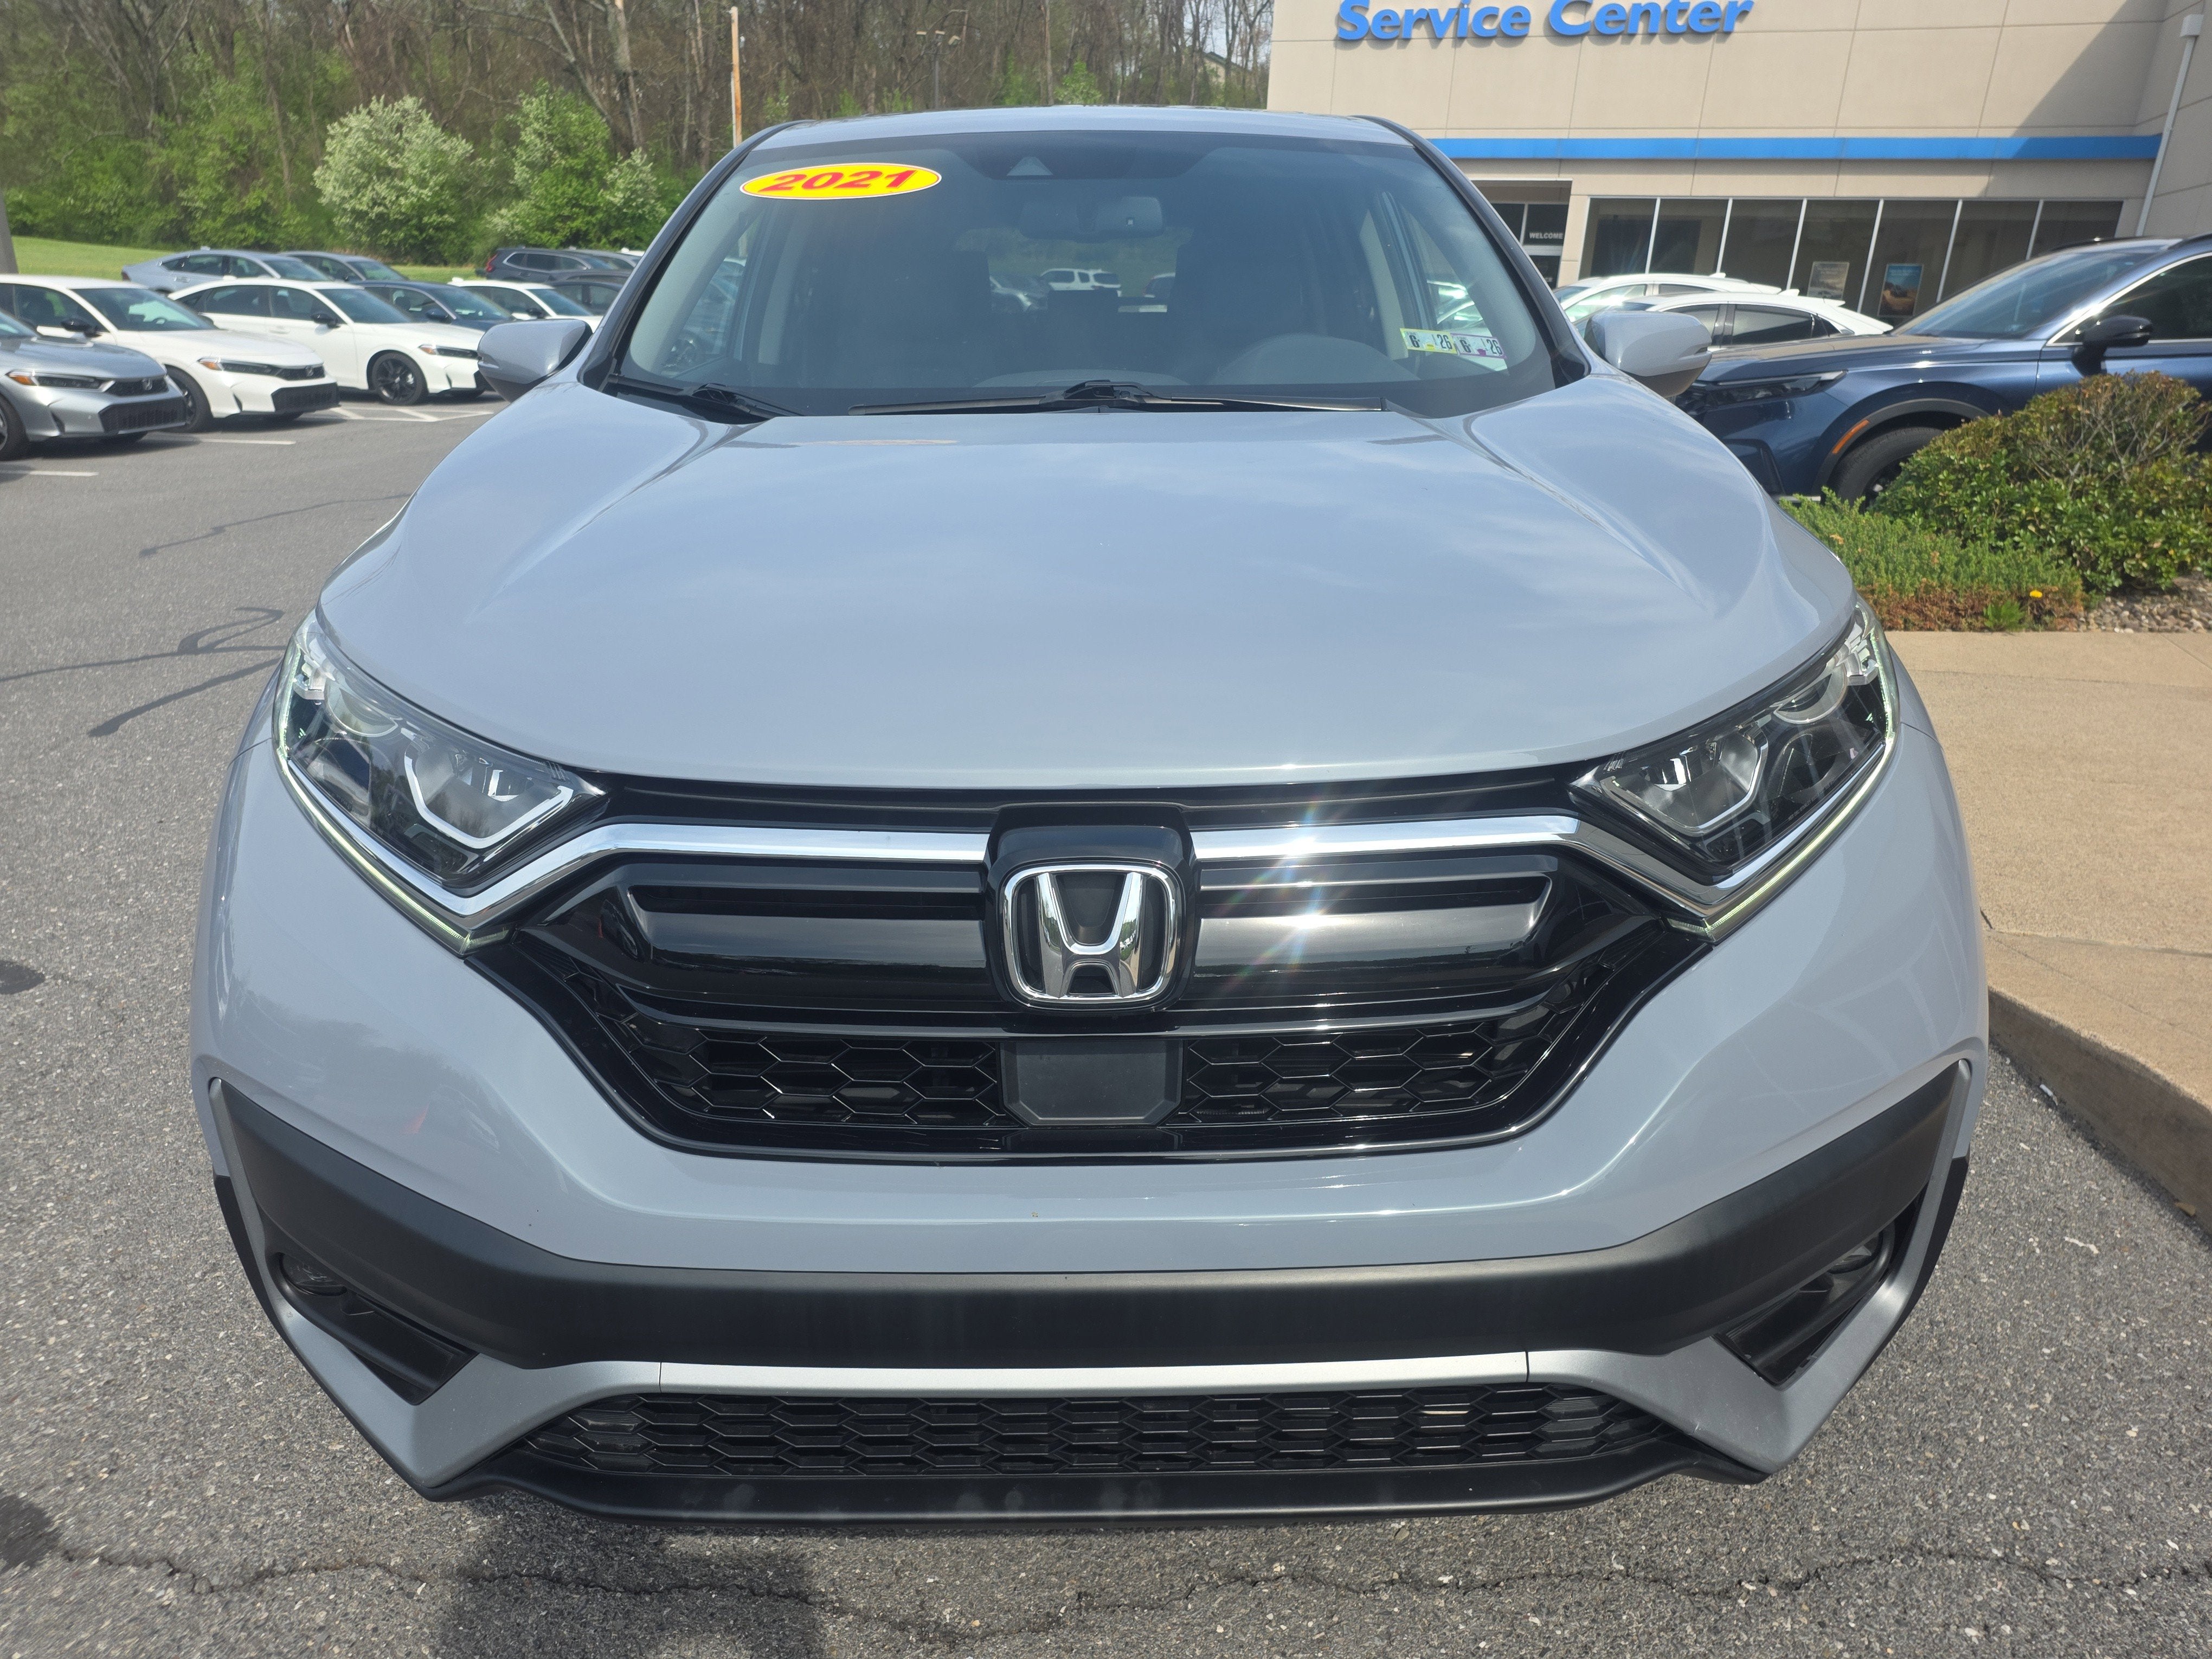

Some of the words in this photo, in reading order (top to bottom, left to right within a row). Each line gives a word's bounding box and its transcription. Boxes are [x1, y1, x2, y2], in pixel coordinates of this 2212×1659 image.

[1338, 0, 1531, 40] Service
[1548, 0, 1755, 36] Center
[757, 170, 917, 192] 2021
[1409, 335, 1420, 348] 6
[1437, 334, 1452, 350] 26
[1459, 339, 1471, 353] 6
[1487, 339, 1503, 355] 26
